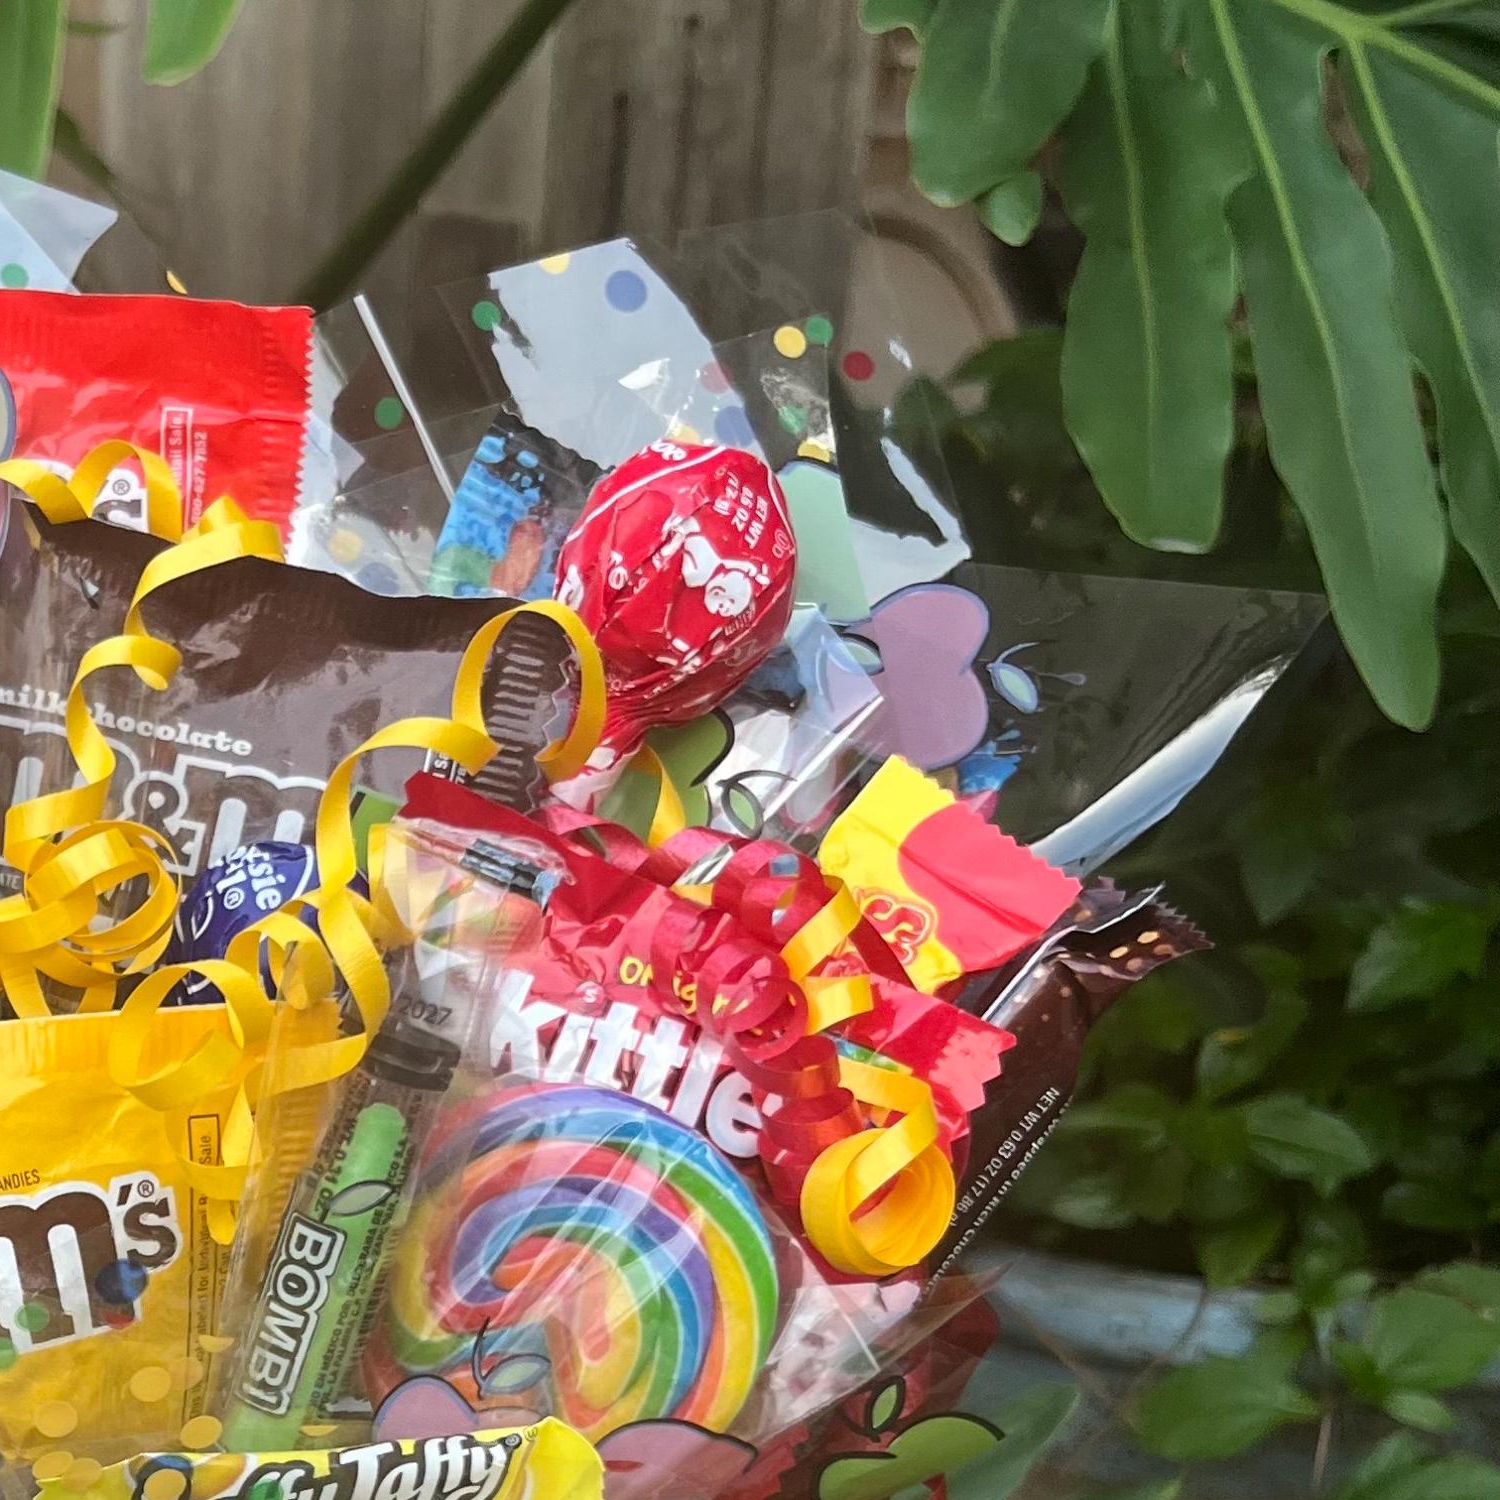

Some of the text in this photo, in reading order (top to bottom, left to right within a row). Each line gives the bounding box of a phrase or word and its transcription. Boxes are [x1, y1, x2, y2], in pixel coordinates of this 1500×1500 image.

[88, 701, 253, 758] hocolate
[1033, 1084, 1060, 1113] NET
[1017, 1107, 1041, 1133] WT
[995, 1128, 1025, 1160] 0.63
[982, 1155, 1004, 1177] OZ
